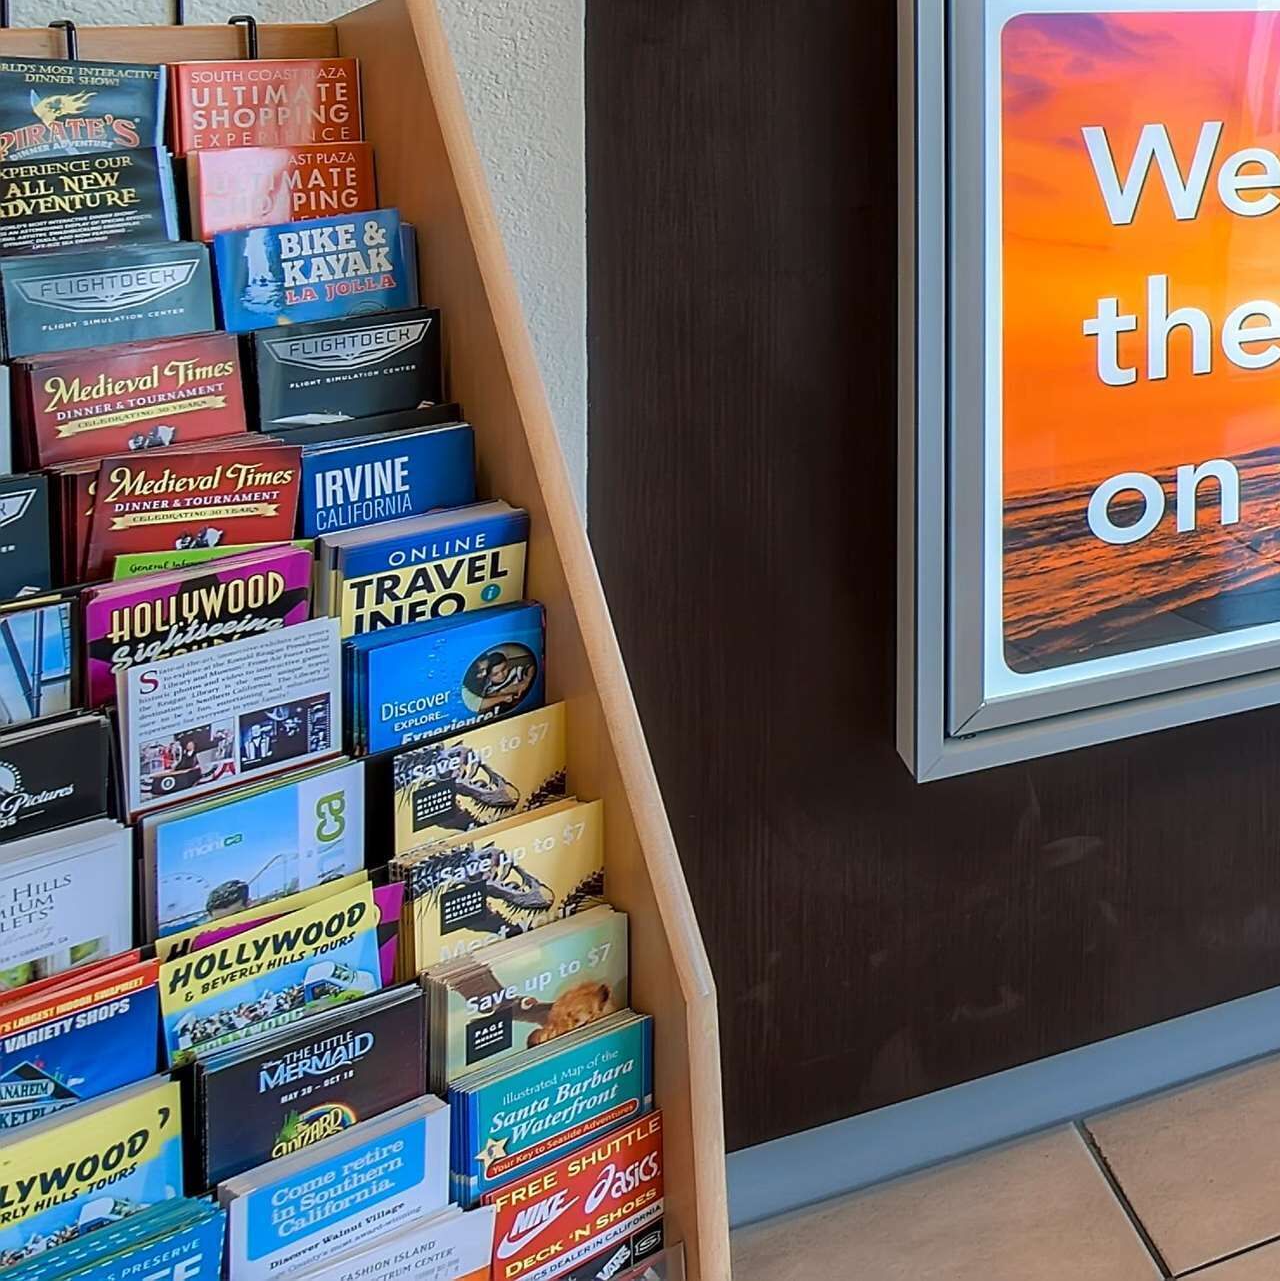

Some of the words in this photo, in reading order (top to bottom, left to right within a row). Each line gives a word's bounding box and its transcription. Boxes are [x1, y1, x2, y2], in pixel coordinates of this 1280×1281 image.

[25, 74, 75, 85] DINNER
[79, 76, 120, 87] SHOW!
[39, 65, 75, 76] MOST
[79, 68, 160, 80] INTERACTIVE
[191, 71, 242, 83] SOUTH
[248, 69, 298, 82] COAST
[191, 82, 348, 107] ULTIMATE
[0, 114, 140, 160] PIRATE'S
[193, 104, 349, 130] SHOPPING
[9, 143, 50, 160] DINNER
[53, 140, 115, 151] ADVENTURE
[95, 156, 133, 169] OUR
[317, 152, 355, 164] PLAZA
[4, 179, 54, 200] ALL
[59, 172, 120, 194] NEW
[278, 224, 356, 259] BIKE
[363, 221, 386, 246] &
[40, 269, 177, 297] FLIGHTDECK
[281, 247, 393, 287] KAYAK
[286, 287, 319, 305] LA
[325, 274, 396, 301] JOLLA
[41, 321, 78, 331] FLIGHT
[83, 313, 144, 326] SIMULATION
[147, 308, 185, 318] CENTER
[289, 328, 411, 357] FLIGHTDECK
[43, 365, 160, 413] Medieval
[163, 358, 236, 388] Times
[289, 378, 321, 389] FLIGHT
[326, 370, 379, 383] SIMULATION
[383, 364, 416, 375] CENTER
[56, 403, 113, 421] DINNER
[115, 400, 126, 410] &
[127, 382, 226, 408] TOURNAMENT
[104, 466, 222, 503] Medieval
[225, 463, 294, 492] Times
[114, 498, 169, 512] DINNER
[172, 498, 182, 508] &
[184, 491, 281, 508] TOURNAMENT
[315, 456, 410, 509] IRVINE
[1086, 456, 1238, 547] on
[316, 493, 413, 531] CALIFORNIA
[388, 533, 486, 566] ONLINE
[350, 551, 508, 610] TRAVEL
[107, 572, 285, 644] HOLLYWOOD
[355, 592, 466, 635] INFO
[111, 615, 284, 674] Sightseeing
[381, 690, 450, 720] Discover
[412, 755, 461, 778] Save
[500, 735, 520, 752] to
[528, 723, 548, 745] $7
[441, 858, 491, 880] Save
[499, 846, 526, 870] up
[533, 836, 555, 854] to
[563, 822, 585, 845] $7
[168, 901, 367, 995] HOLLYWOOD
[184, 990, 194, 1002] &
[201, 962, 263, 995] BEVERLY
[266, 951, 305, 970] HILLS
[312, 931, 355, 958] TOURS
[465, 984, 518, 1015] Save
[525, 971, 551, 993] up
[560, 959, 580, 977] to
[588, 942, 611, 967] $7
[5, 1019, 74, 1053] VARIETY
[75, 999, 131, 1029] SHOPS
[13, 1009, 55, 1030] LARGEST
[475, 1022, 503, 1038] PAGE
[259, 1032, 375, 1093] MERMAID
[284, 1046, 313, 1065] THE
[313, 1030, 354, 1055] LITTLE
[490, 1096, 549, 1134] Santa
[553, 1057, 634, 1105] Barbara
[503, 1075, 558, 1105] Illustrated
[561, 1065, 584, 1081] Map
[587, 1056, 601, 1070] of
[602, 1049, 619, 1062] the
[280, 1092, 300, 1104] MAY
[511, 1084, 618, 1144] Waterfront
[492, 1159, 514, 1174] Your
[516, 1150, 535, 1165] Key
[535, 1145, 545, 1155] to
[546, 1127, 582, 1150] Seaside
[583, 1104, 634, 1133] Adventures
[271, 1169, 336, 1206] Come
[341, 1139, 405, 1177] retire
[496, 1171, 558, 1213] FREE
[567, 1117, 661, 1177] SHUTTLE
[34, 1187, 79, 1211] HILLS
[87, 1162, 138, 1194] TOURS
[271, 1207, 295, 1226] in
[299, 1157, 404, 1213] Southern
[277, 1178, 396, 1238] California.
[509, 1189, 569, 1238] NIKE
[269, 1240, 320, 1270] Discover
[322, 1217, 363, 1245] Walnut
[364, 1201, 405, 1224] Village
[505, 1236, 564, 1278] DECK
[596, 1189, 657, 1230] SHOES
[550, 1247, 590, 1271] DEALER
[592, 1238, 603, 1250] IN
[605, 1204, 661, 1238] CALIFORNIA
[122, 1238, 200, 1278] PRESERVE
[340, 1257, 391, 1281] FASHION
[394, 1240, 436, 1263] ISLAND
[415, 1247, 455, 1268] CENTER
[596, 1244, 631, 1281] VANS
